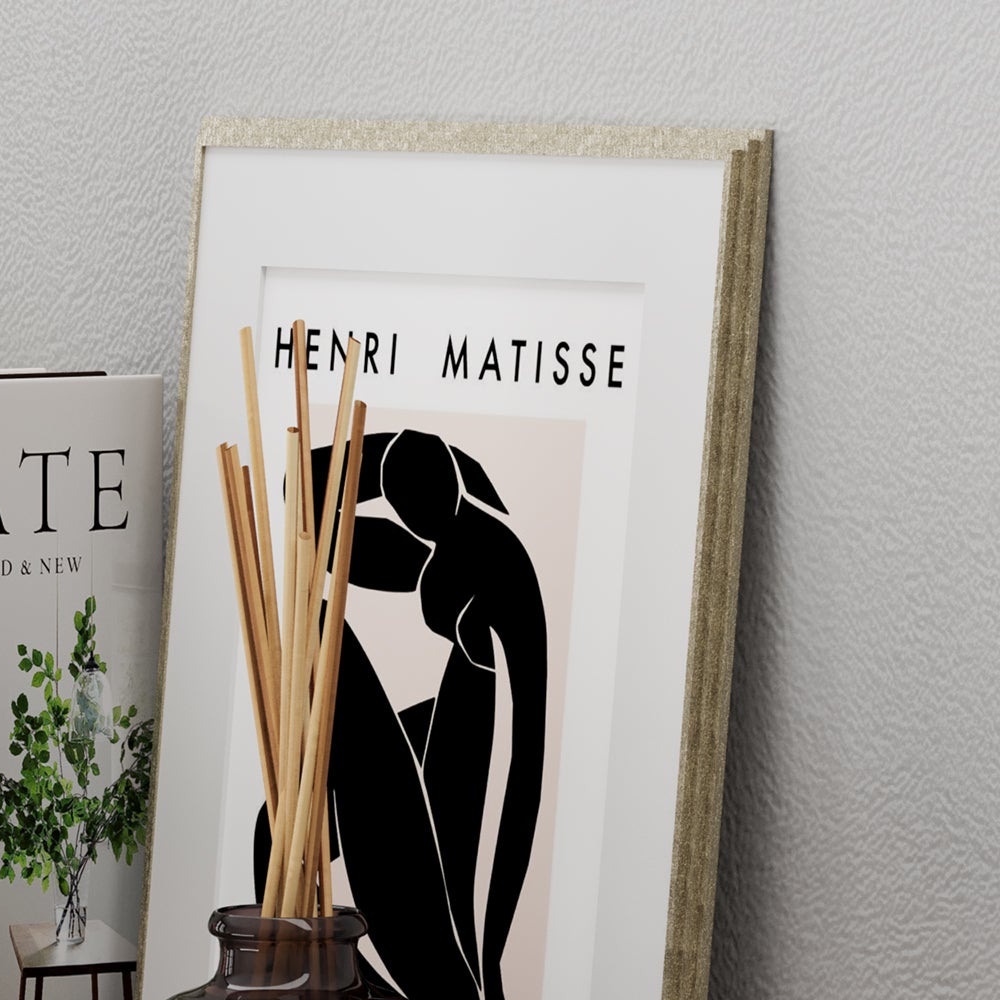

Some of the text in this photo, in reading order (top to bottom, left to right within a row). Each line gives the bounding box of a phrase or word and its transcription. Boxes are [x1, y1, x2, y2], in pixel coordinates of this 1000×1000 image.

[274, 327, 626, 388] HENRI MATISSE
[20, 559, 32, 576] &
[39, 556, 83, 575] NEW
